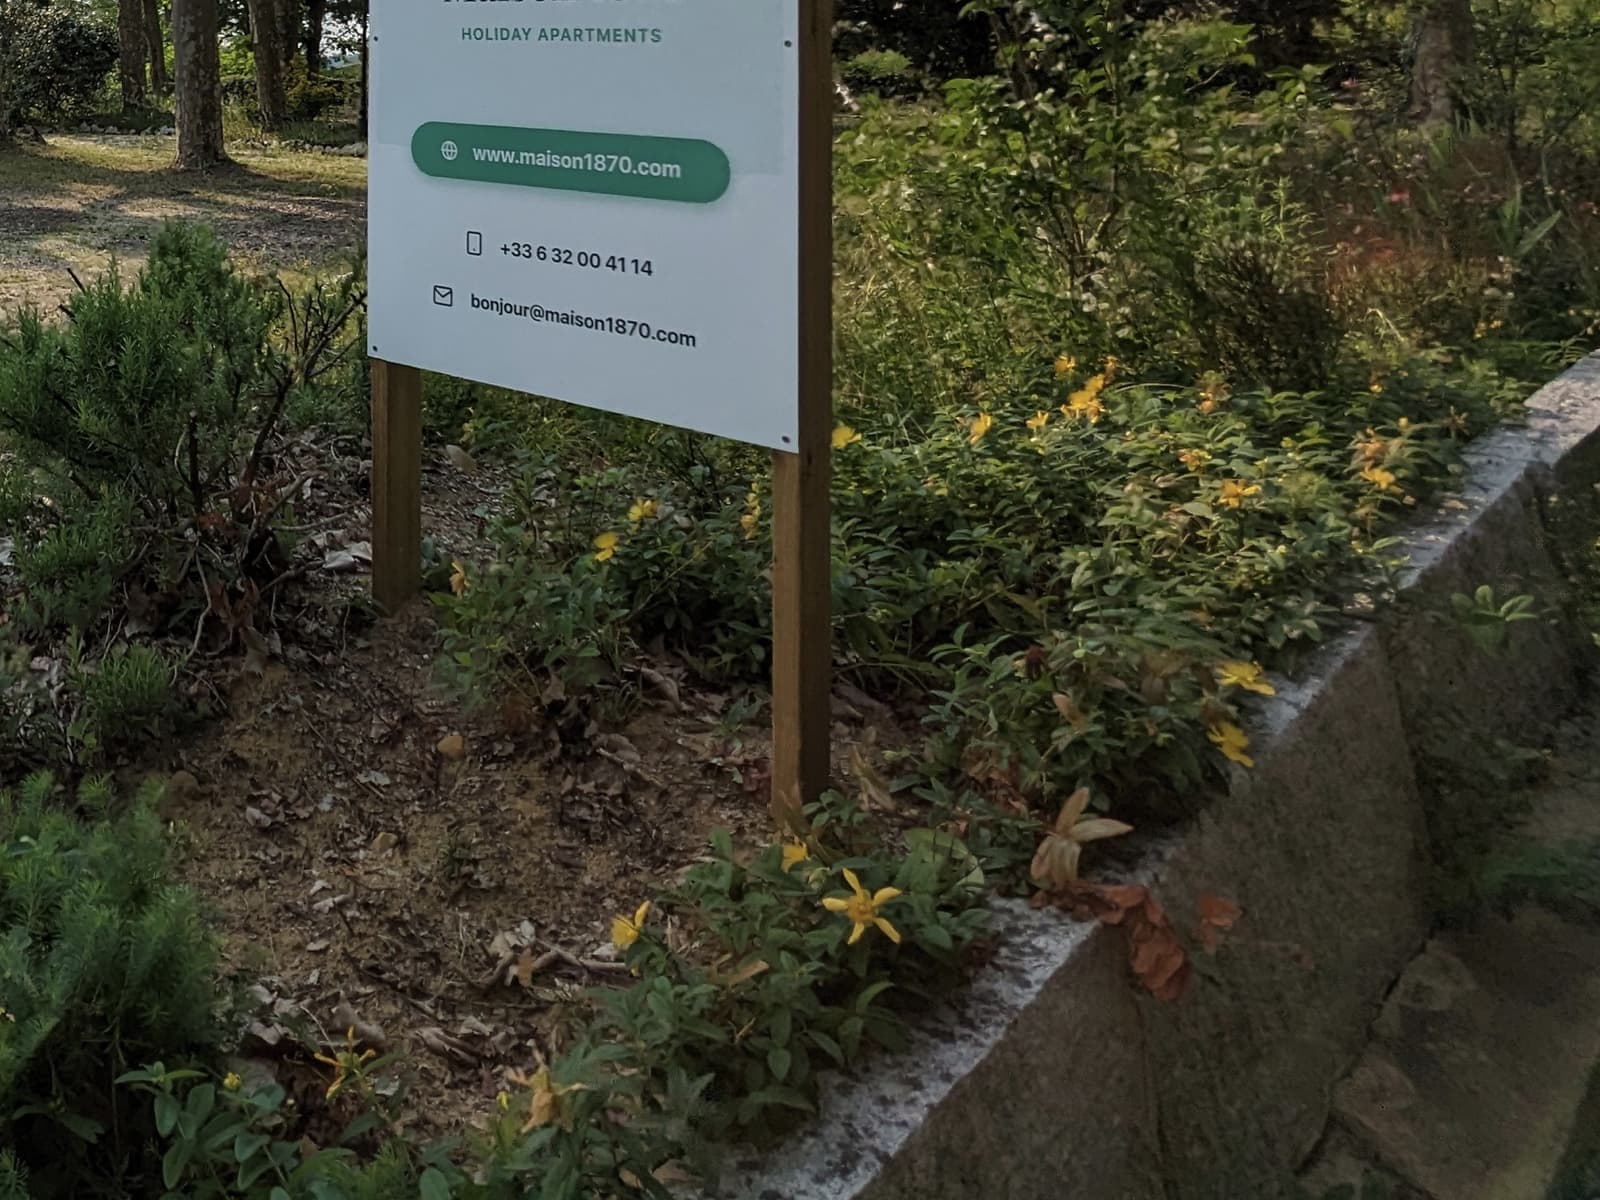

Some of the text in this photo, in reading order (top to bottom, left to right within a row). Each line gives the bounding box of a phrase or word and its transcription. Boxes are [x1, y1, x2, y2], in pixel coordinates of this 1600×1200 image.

[461, 27, 662, 43] HOLIDAY APARTMENTS
[472, 146, 681, 178] www.maison1870.com
[500, 242, 653, 277] +33 6 32 00 41 14
[471, 293, 696, 348] bonjour@maison1870.com
